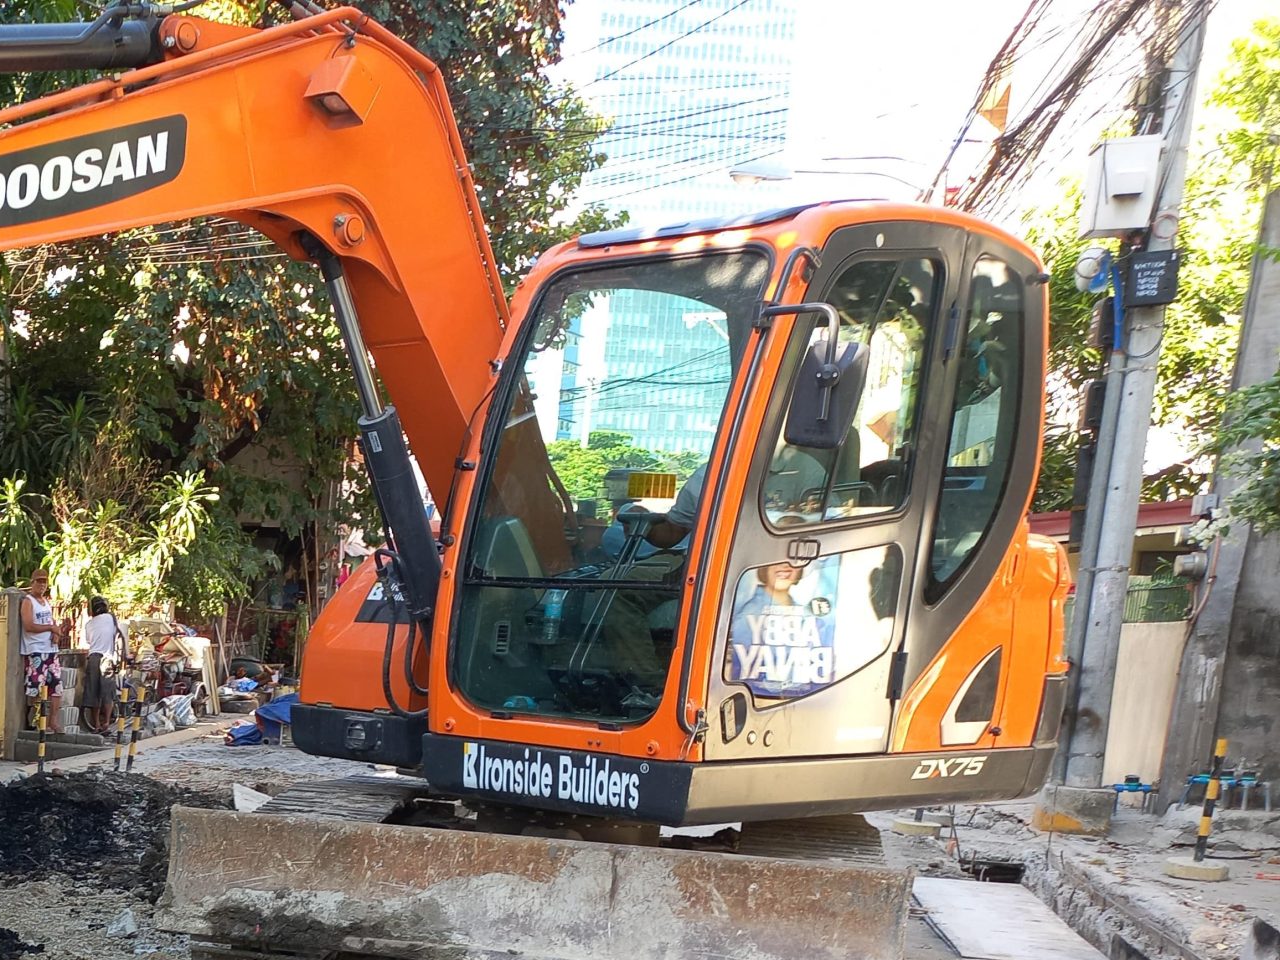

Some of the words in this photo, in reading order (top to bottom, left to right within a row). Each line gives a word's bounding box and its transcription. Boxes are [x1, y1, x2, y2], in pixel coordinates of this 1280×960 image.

[479, 745, 553, 798] Ironside
[558, 754, 640, 810] Builders
[910, 756, 988, 780] DX75
